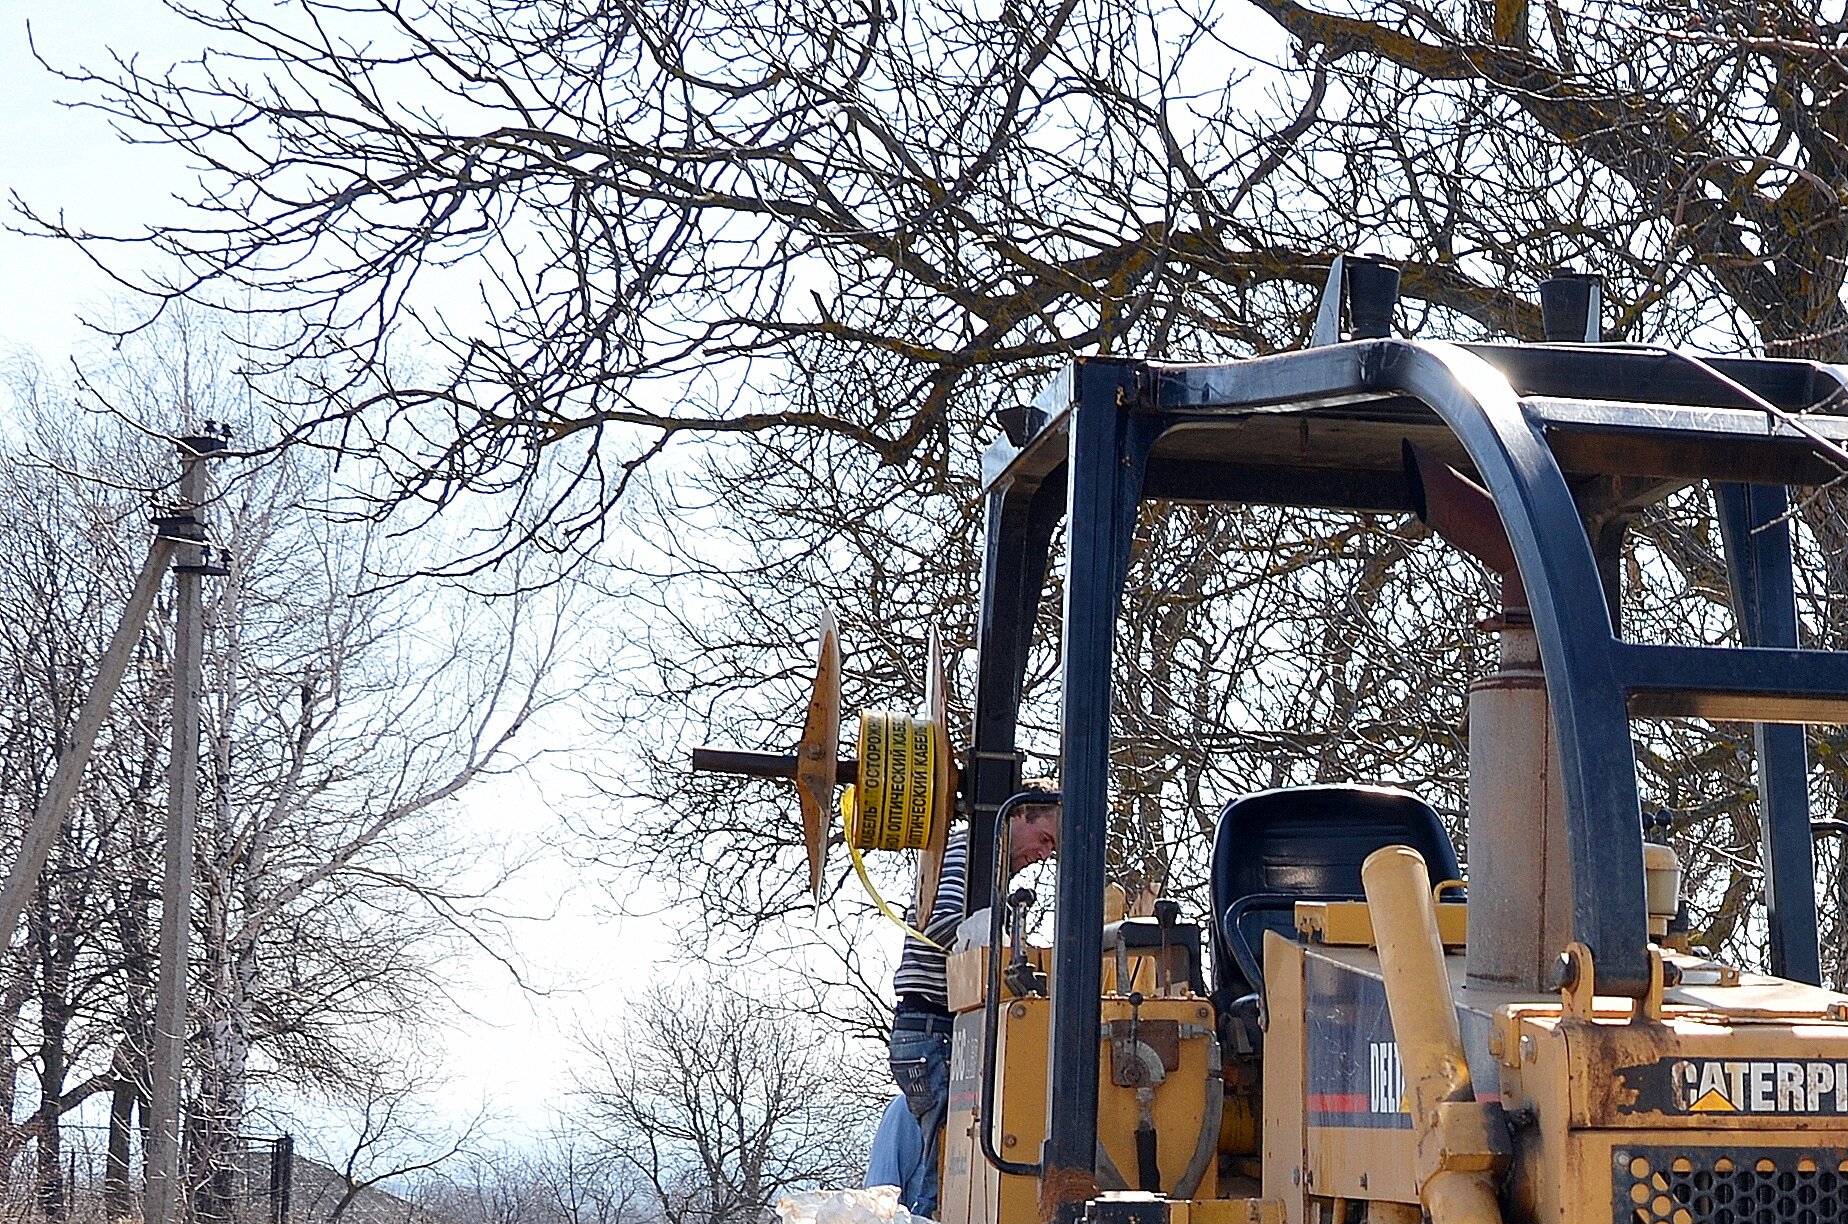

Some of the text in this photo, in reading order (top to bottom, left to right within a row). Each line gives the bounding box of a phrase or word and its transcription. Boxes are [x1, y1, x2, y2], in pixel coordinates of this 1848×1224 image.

[892, 718, 906, 746] КАБЕ
[888, 749, 906, 832] ОПТИЧЕСКИЙ
[908, 770, 927, 845] ОПТИЧЕСКИЙ
[1369, 1041, 1406, 1113] DELT
